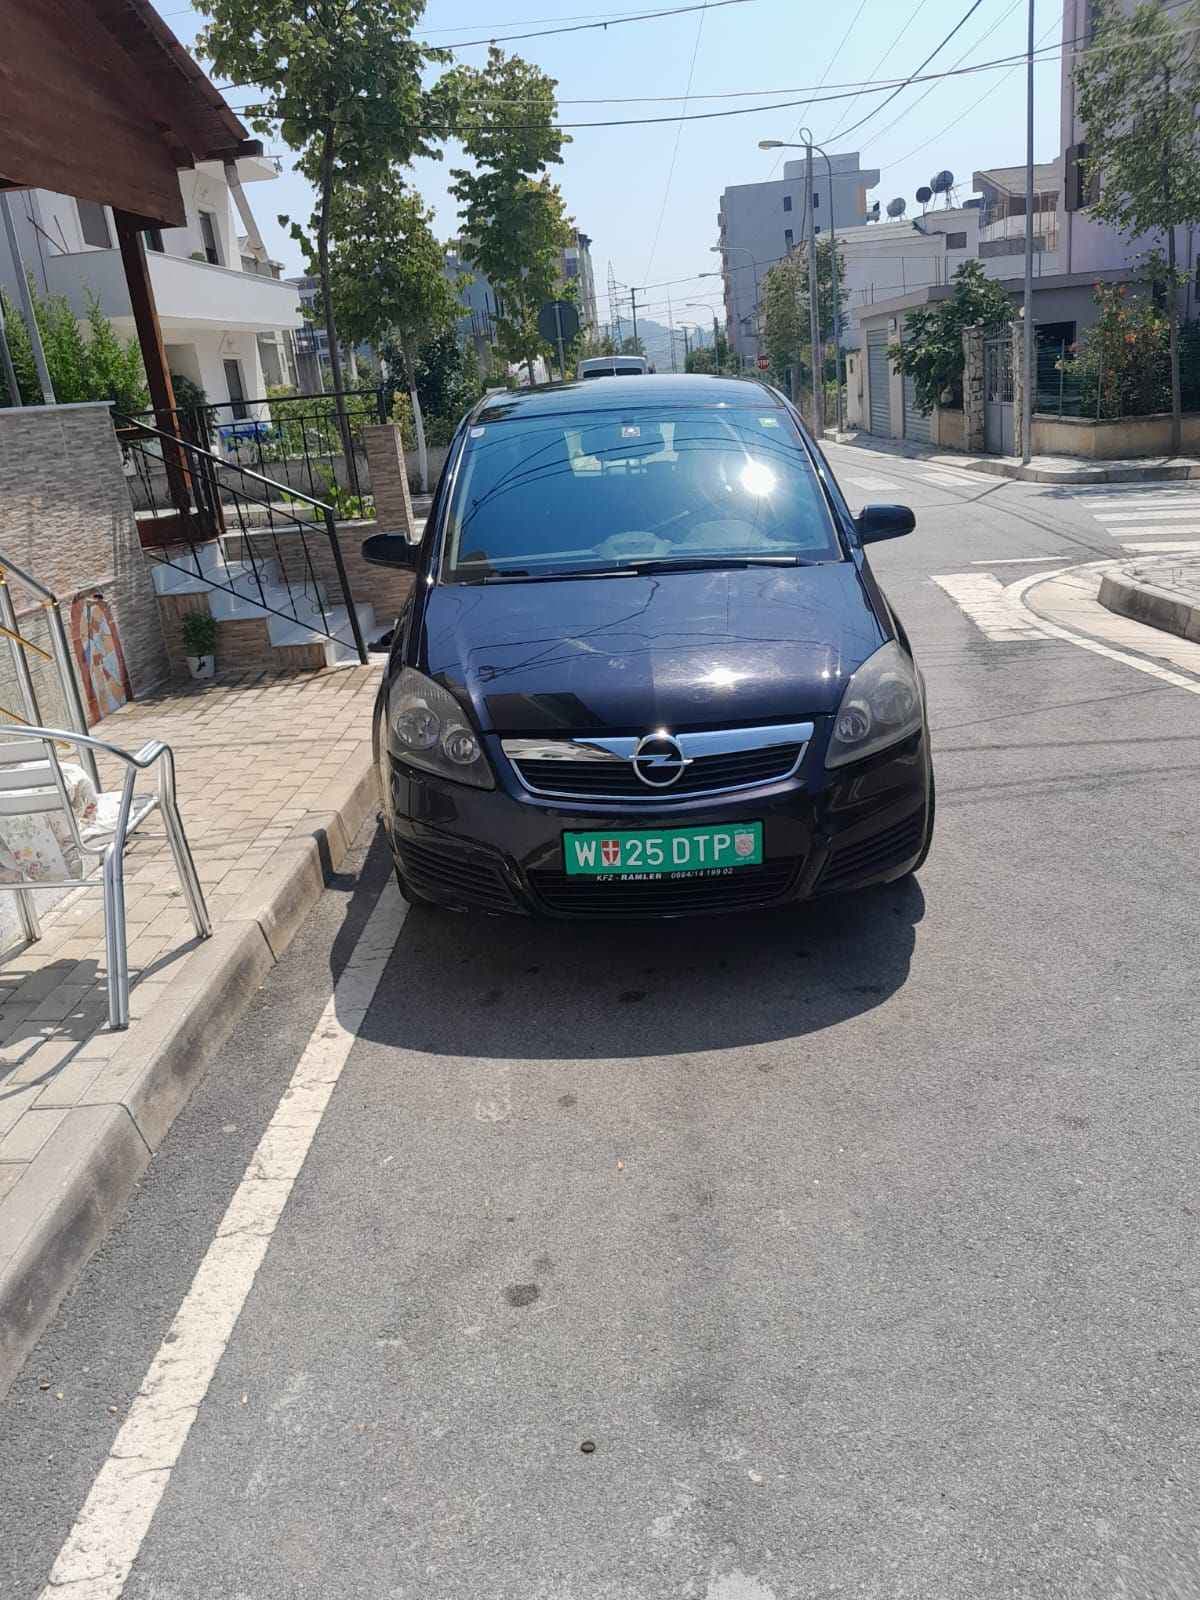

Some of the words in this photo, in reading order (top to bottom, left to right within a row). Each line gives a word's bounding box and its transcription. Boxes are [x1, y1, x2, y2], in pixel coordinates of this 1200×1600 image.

[574, 840, 597, 867] W
[625, 839, 664, 866] 25
[672, 833, 731, 865] DTP
[621, 873, 662, 881] RAMLER
